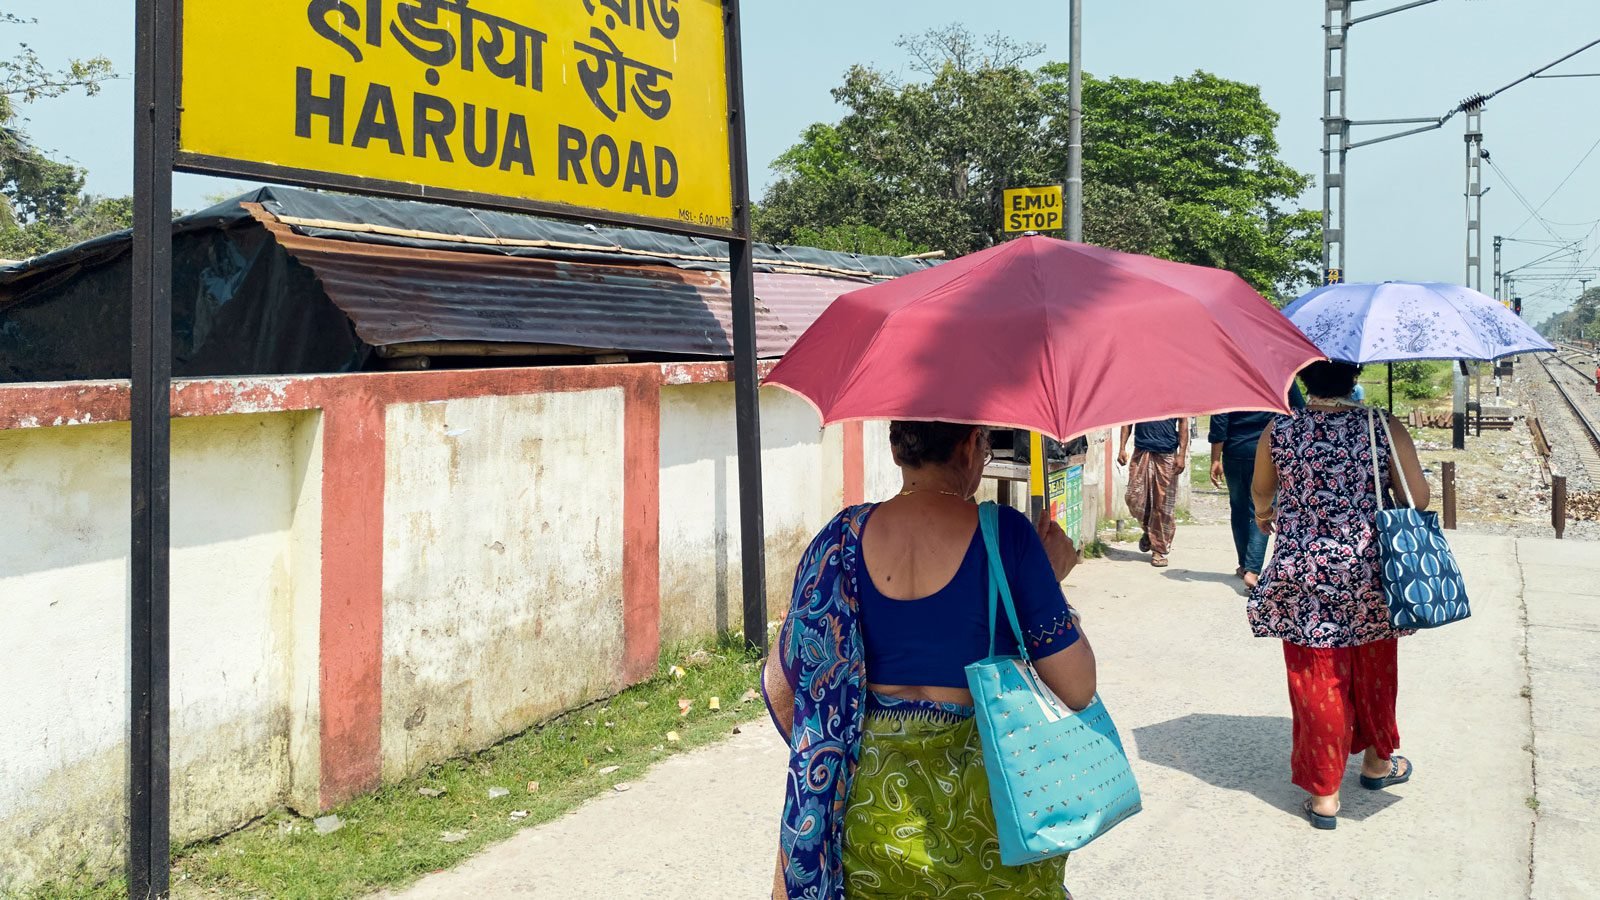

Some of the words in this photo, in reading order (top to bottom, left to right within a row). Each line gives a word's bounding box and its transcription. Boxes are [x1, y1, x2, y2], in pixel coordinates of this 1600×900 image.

[573, 26, 673, 122] रोड
[295, 66, 535, 176] HARUA
[558, 123, 679, 198] ROAD
[1009, 211, 1058, 230] STOP
[1012, 193, 1059, 211] E.M.U.
